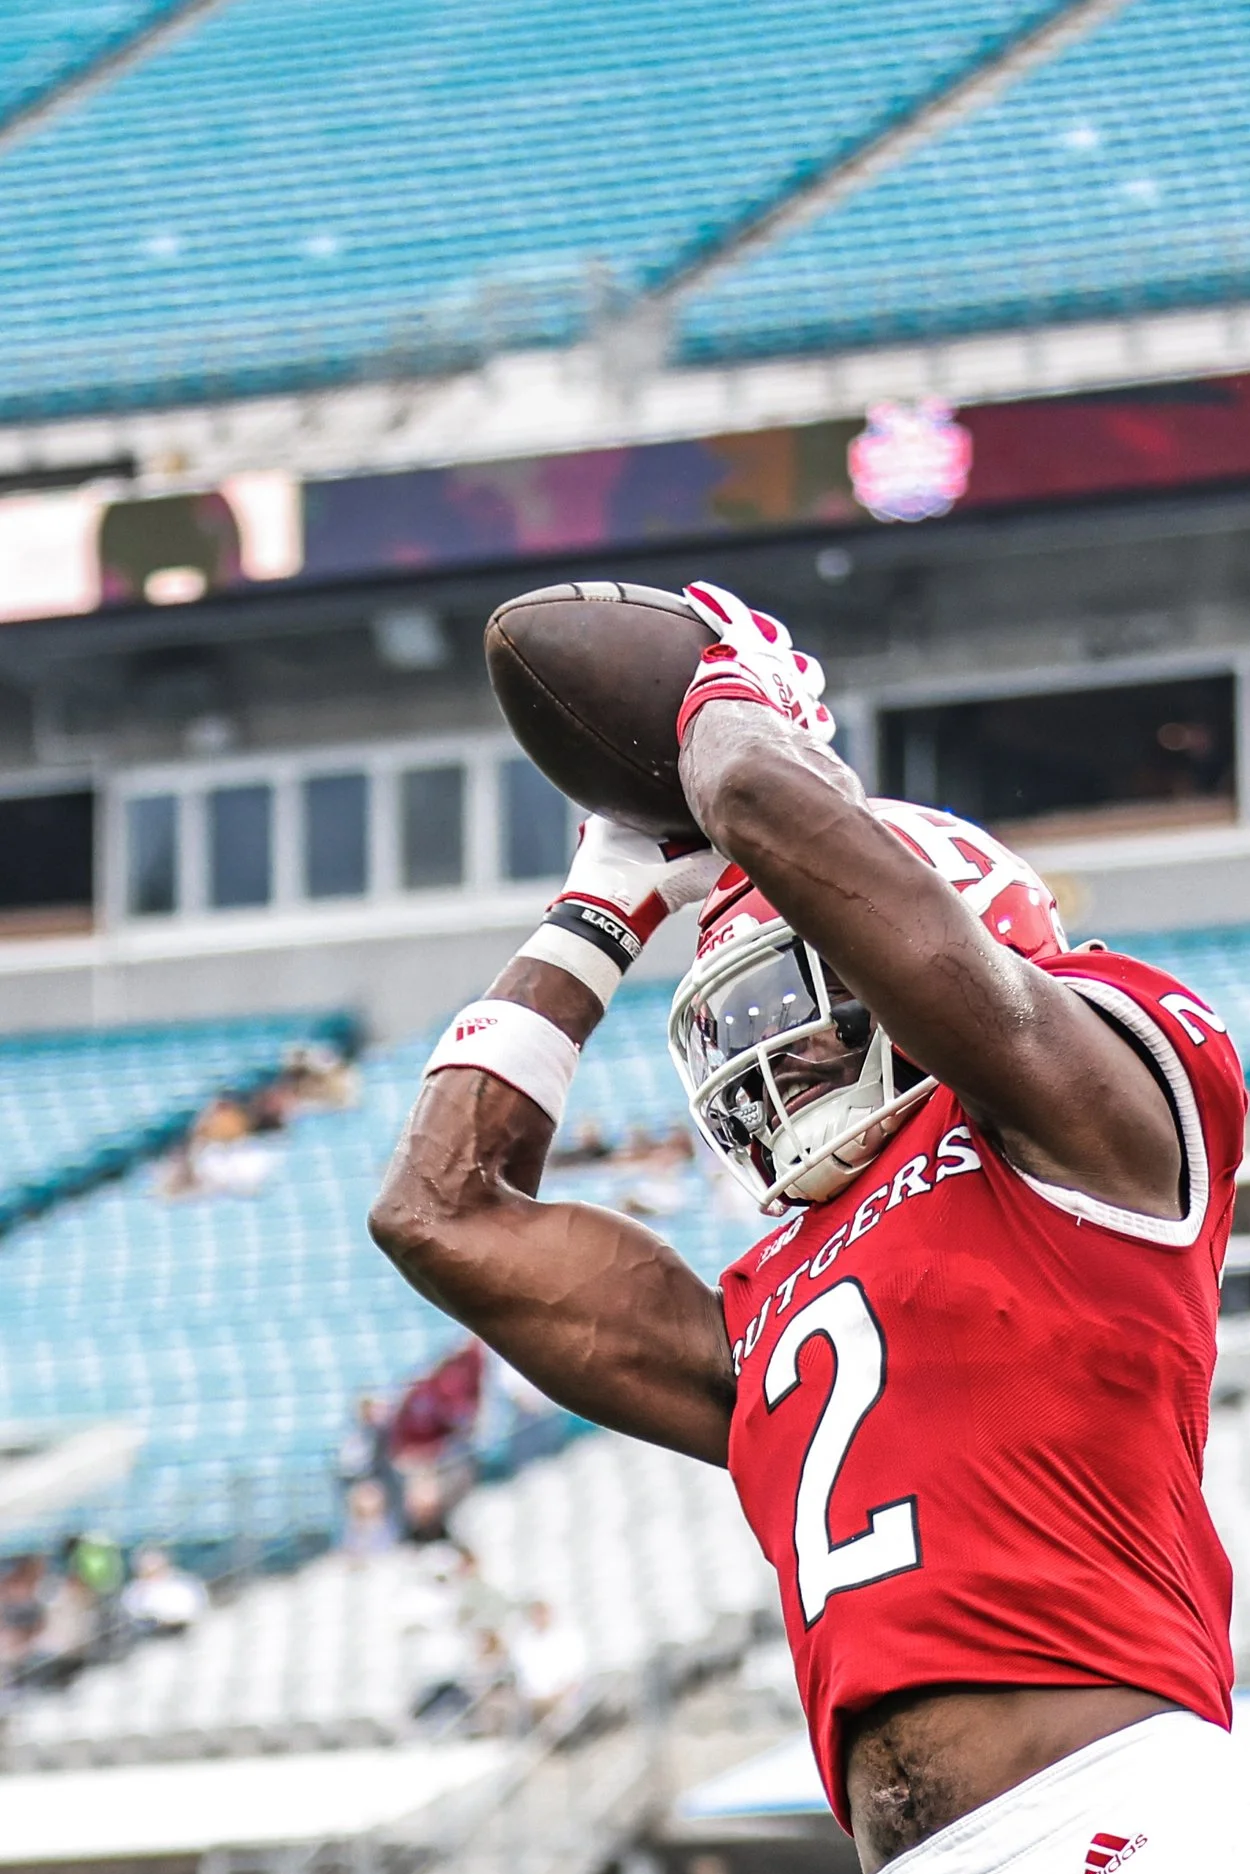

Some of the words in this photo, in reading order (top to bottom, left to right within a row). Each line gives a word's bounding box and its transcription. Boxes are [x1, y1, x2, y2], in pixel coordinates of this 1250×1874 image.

[772, 673, 795, 717] adi
[580, 908, 624, 940] BLACK
[1157, 992, 1227, 1047] 2
[763, 1275, 923, 1631] 2
